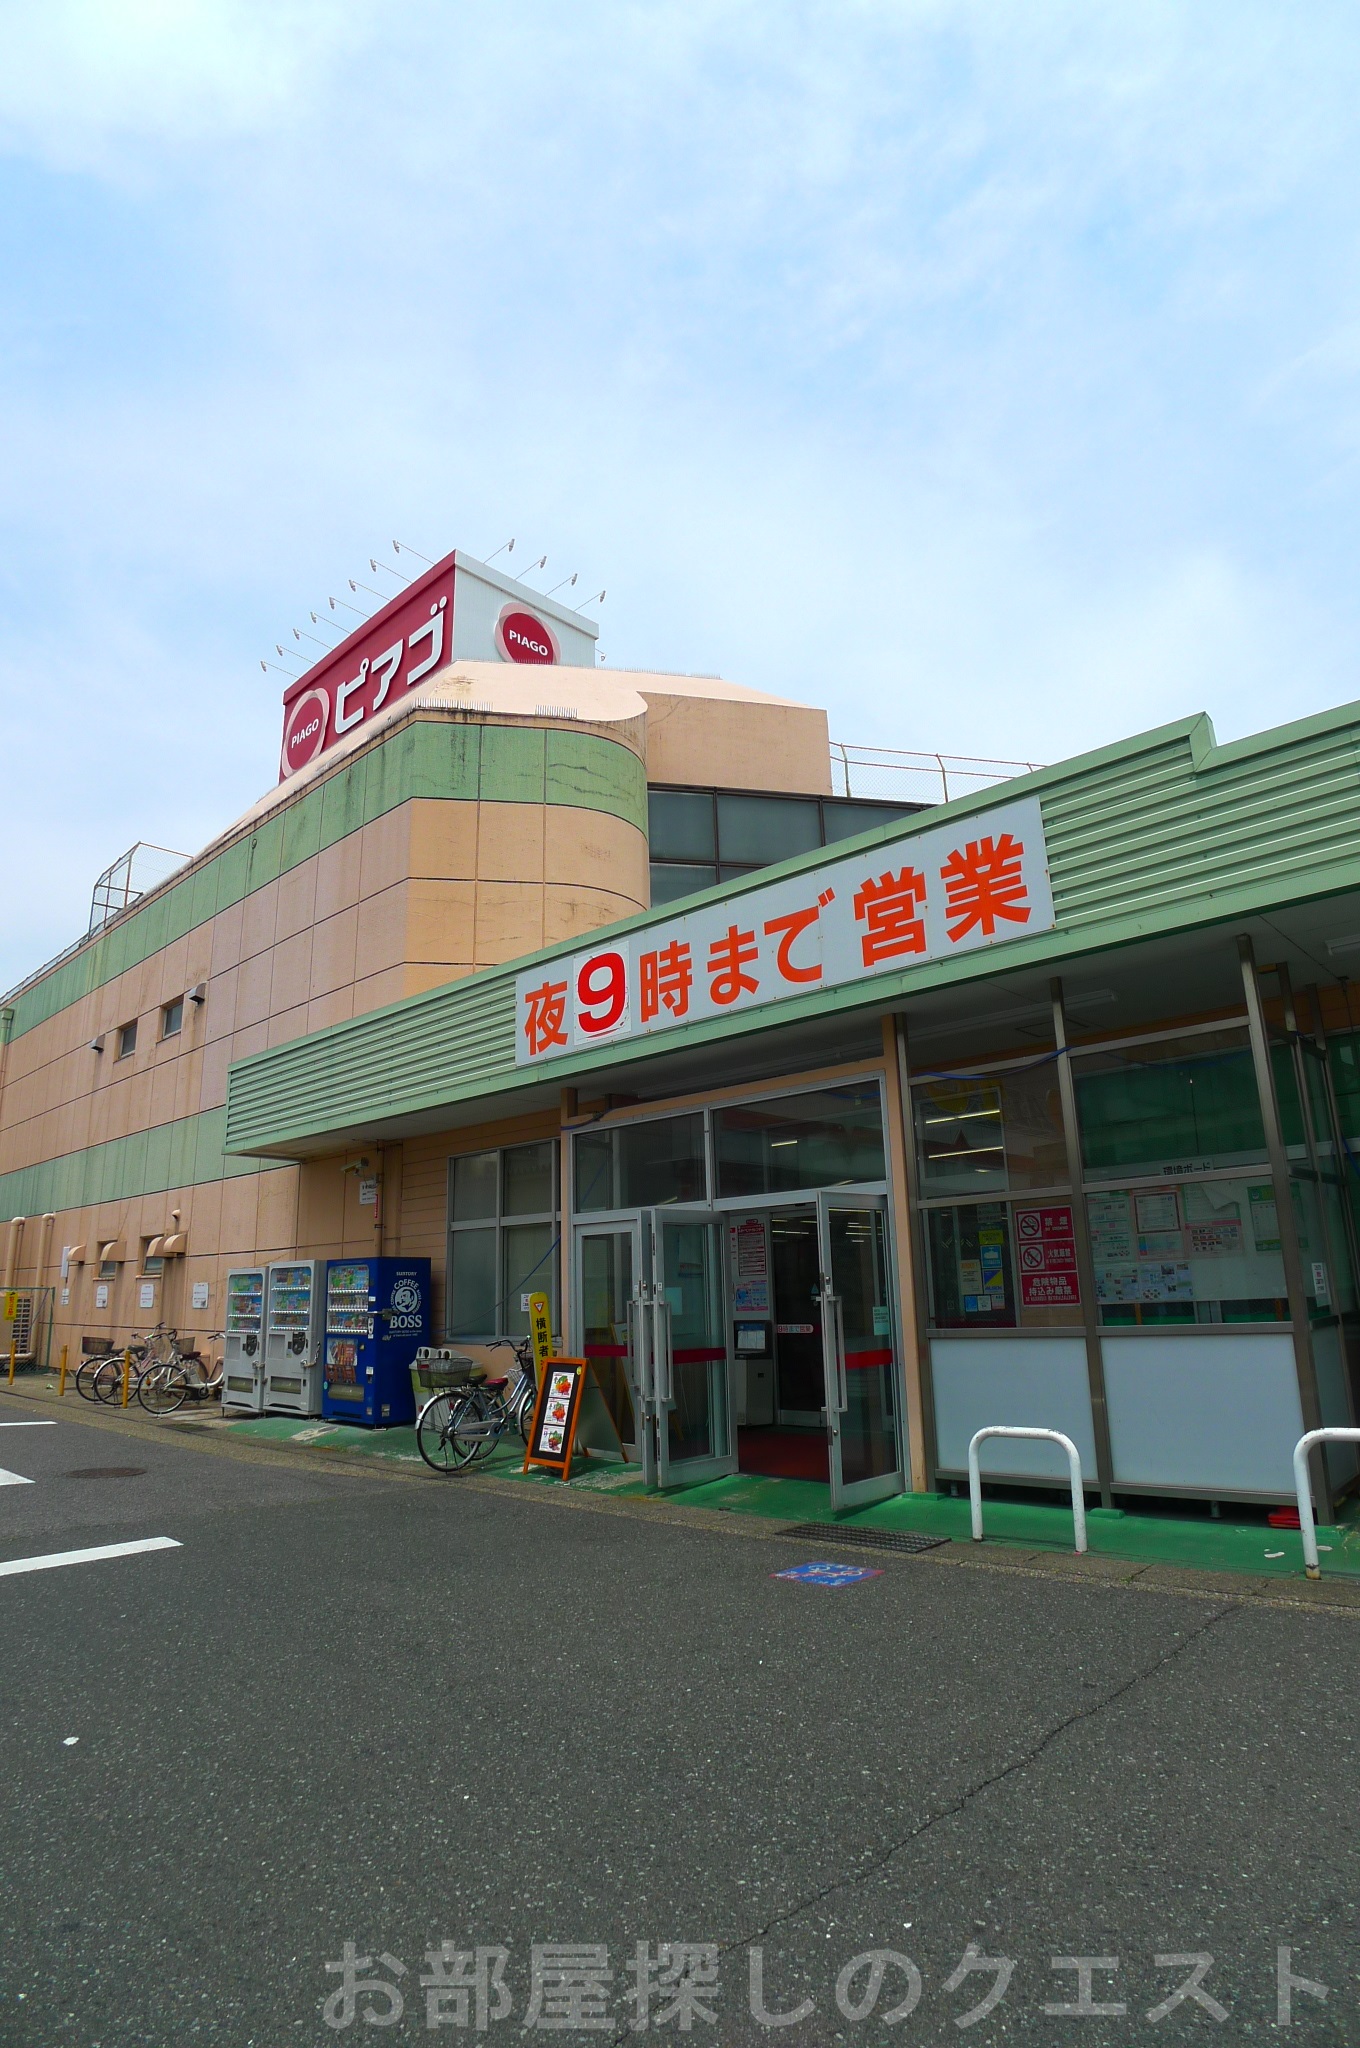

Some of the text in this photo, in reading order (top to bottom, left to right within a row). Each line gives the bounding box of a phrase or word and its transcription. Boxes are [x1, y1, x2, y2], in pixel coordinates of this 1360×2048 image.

[508, 628, 549, 657] PIAGO
[334, 595, 448, 734] ピアゴ
[290, 718, 320, 749] PIAGO
[523, 832, 1032, 1056] 夜9時まで営業
[1163, 1162, 1211, 1175] 環境ボード
[393, 1278, 420, 1290] COFFEE
[1032, 1276, 1068, 1286] 危険物品
[389, 1314, 423, 1329] BOSS
